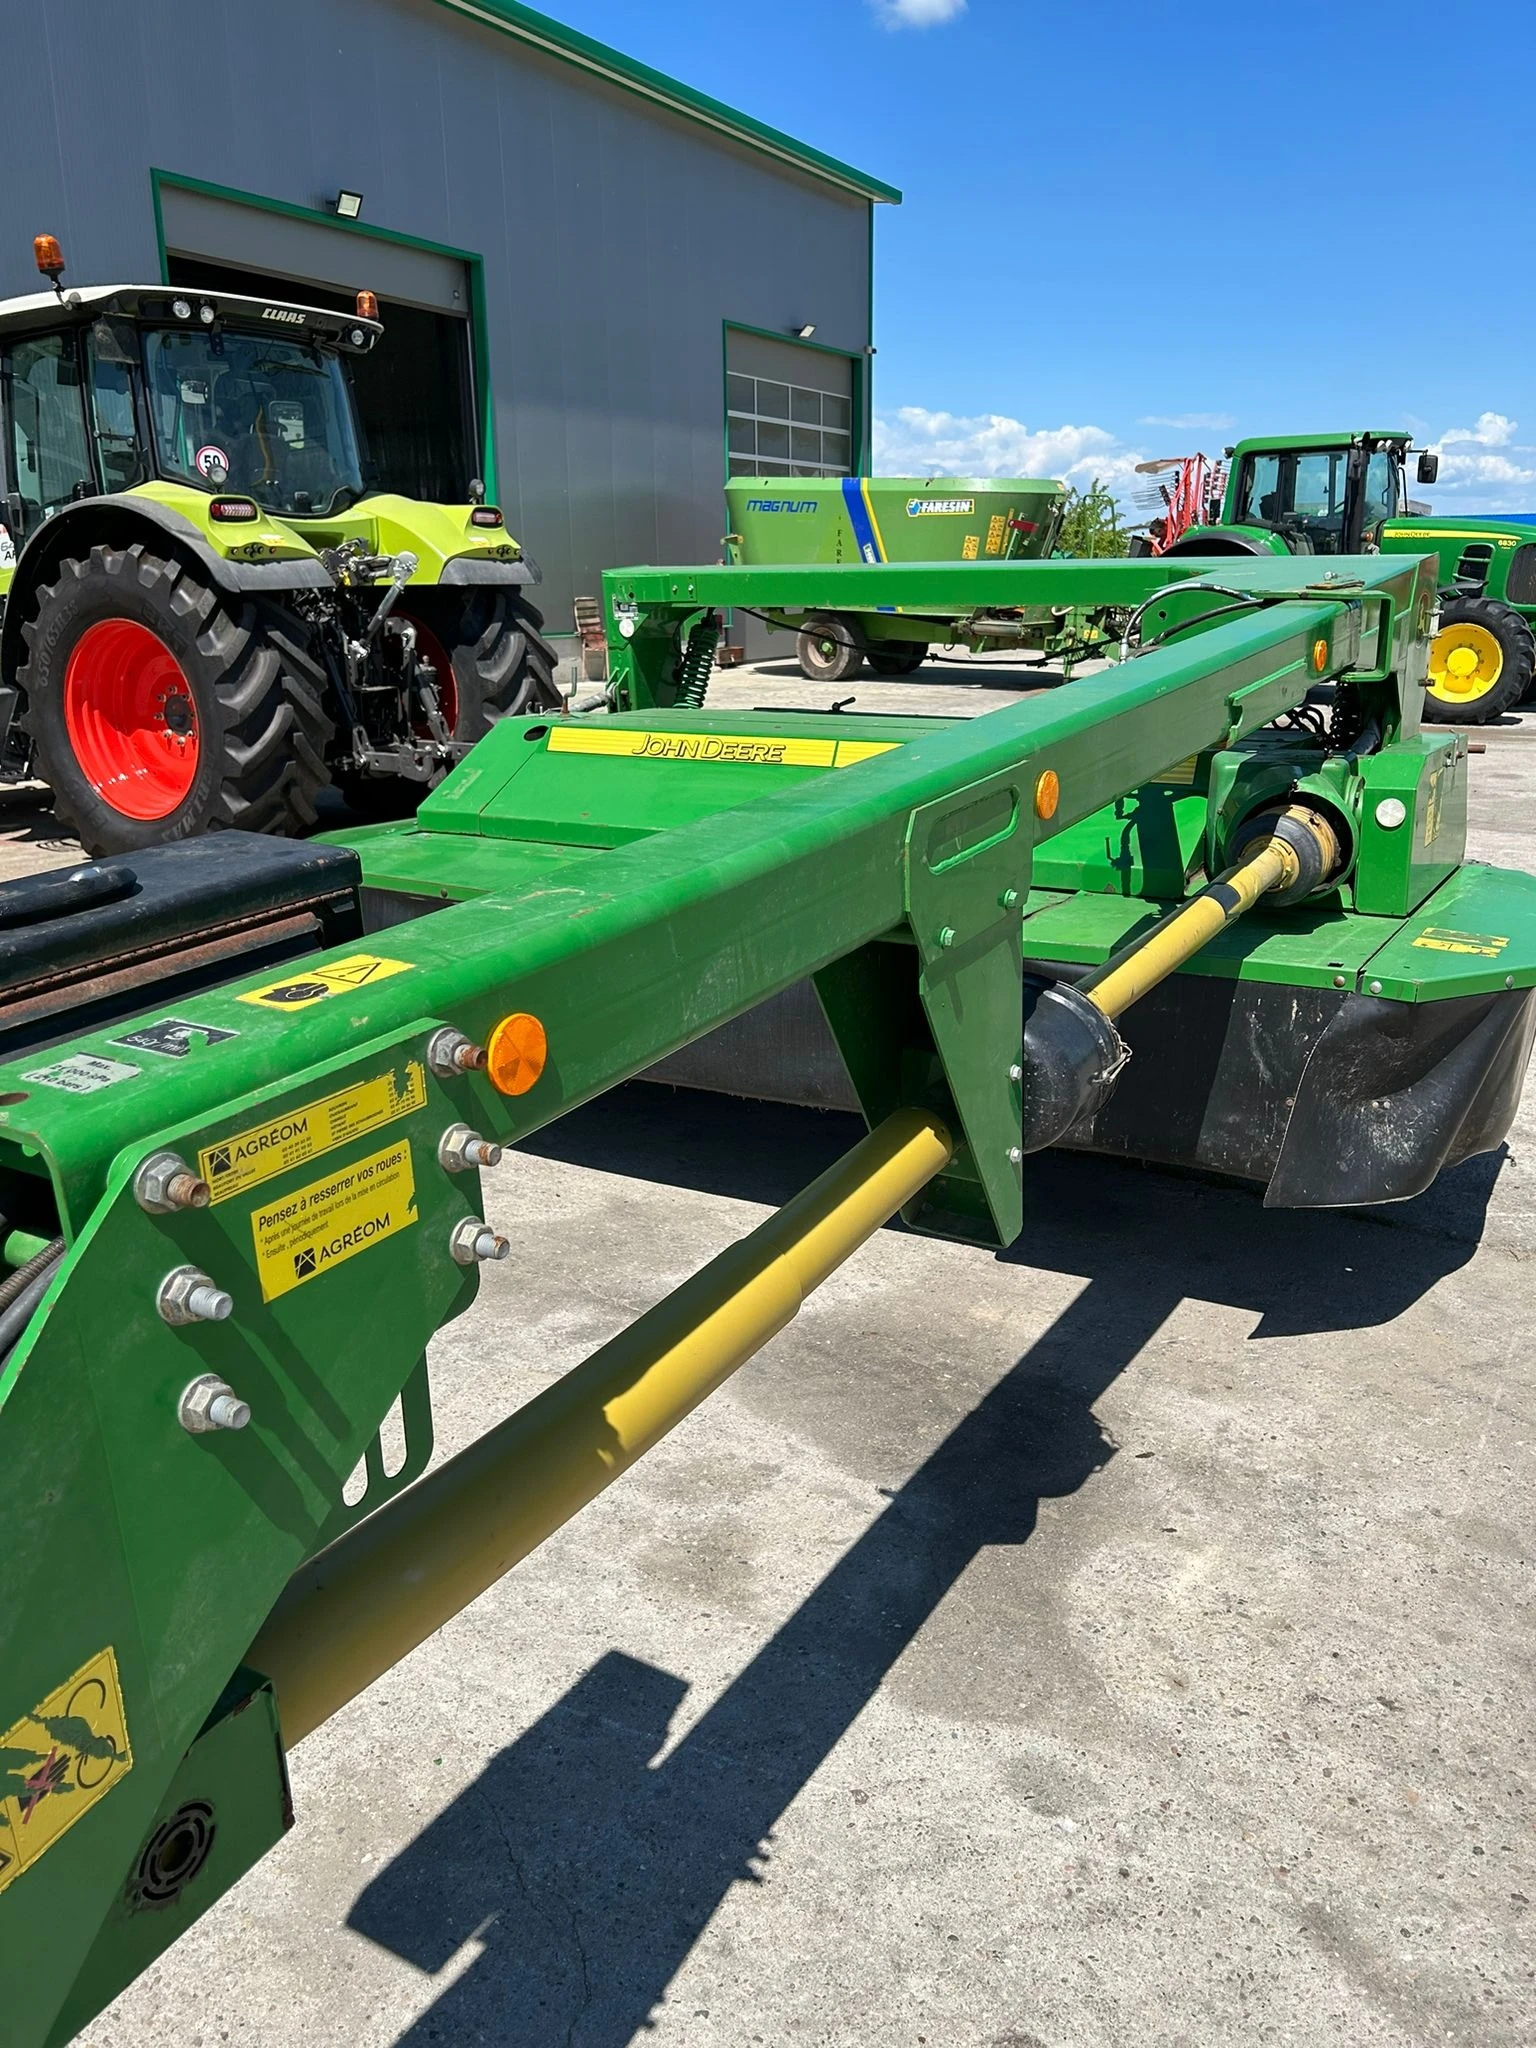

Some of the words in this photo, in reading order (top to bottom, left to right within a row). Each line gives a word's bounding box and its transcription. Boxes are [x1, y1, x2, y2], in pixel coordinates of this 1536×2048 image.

[261, 307, 307, 324] CLAAS
[203, 454, 221, 470] 50
[920, 501, 971, 513] FARESIN
[632, 734, 699, 758] JOHN
[699, 738, 787, 763] DEERE
[235, 1117, 308, 1162] AGRÉOM
[259, 1203, 298, 1232] Pensez
[300, 1197, 307, 1211] à
[309, 1174, 355, 1206] resserrer
[357, 1166, 374, 1183] vos
[375, 1151, 402, 1175] roues
[311, 1212, 319, 1222] de
[319, 1213, 391, 1263] AGRÉOM
